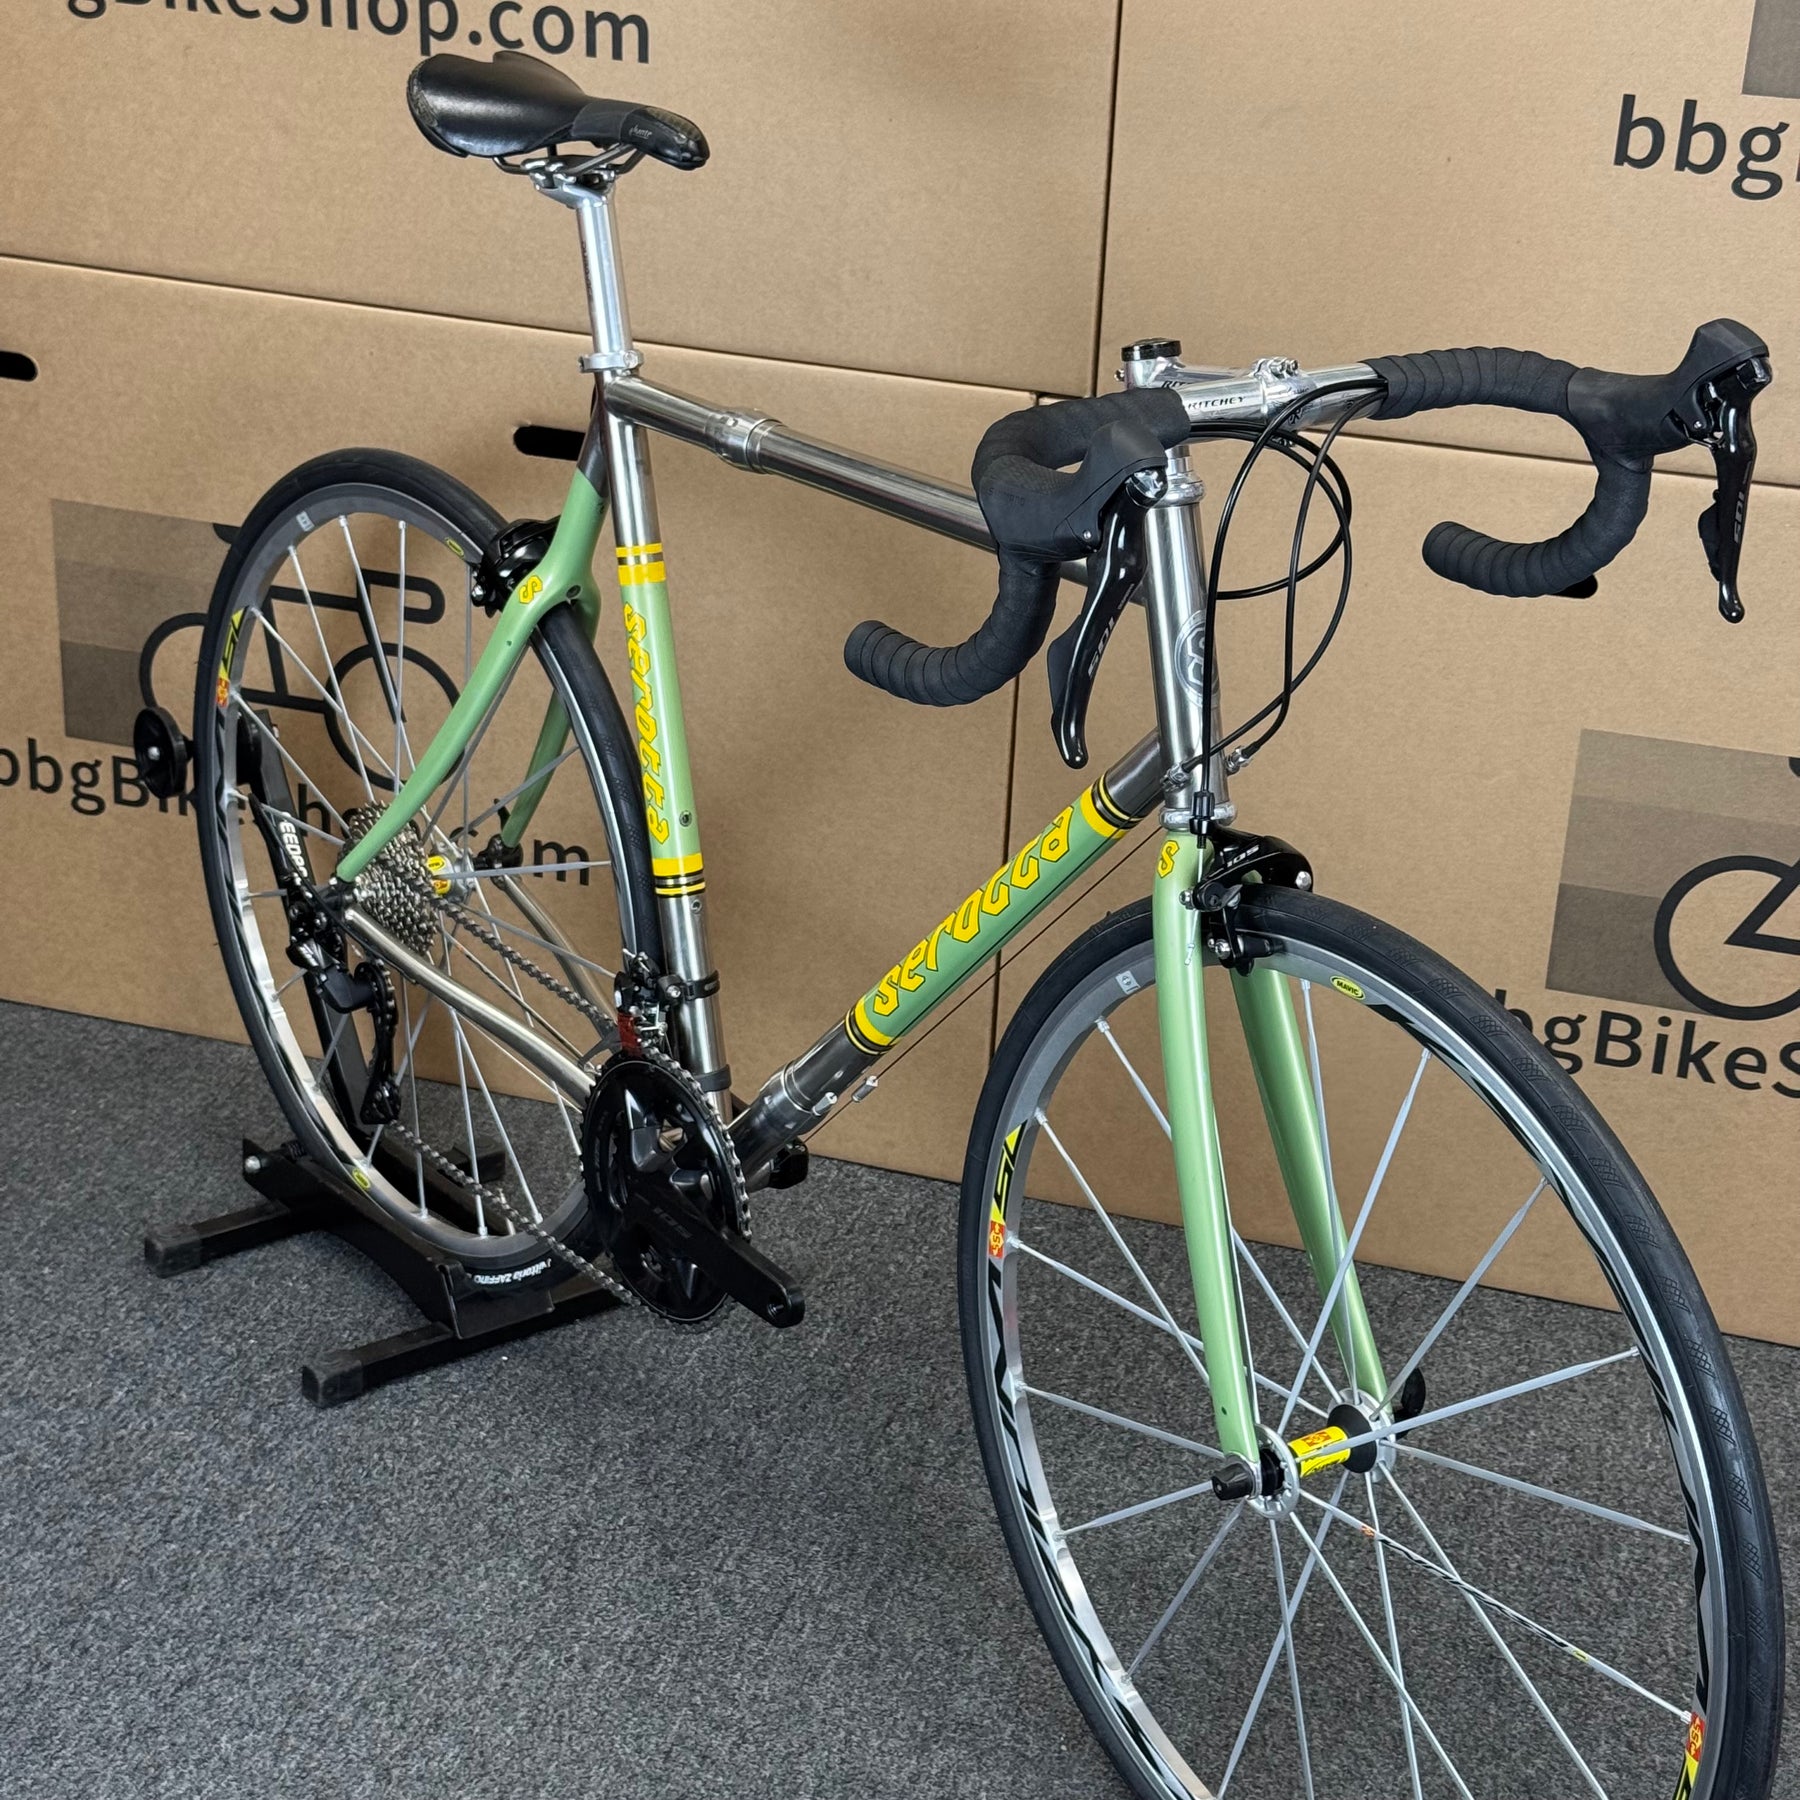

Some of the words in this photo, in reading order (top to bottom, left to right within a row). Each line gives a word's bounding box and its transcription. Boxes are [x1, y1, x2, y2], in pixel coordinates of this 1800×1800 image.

[1613, 93, 1800, 201] bbg
[1188, 396, 1246, 410] RITCHEY
[1088, 616, 1116, 680] 105
[623, 602, 670, 845] serotta
[1227, 844, 1260, 868] 105
[872, 805, 1075, 1017] serotta
[1336, 980, 1360, 996] MAVIC
